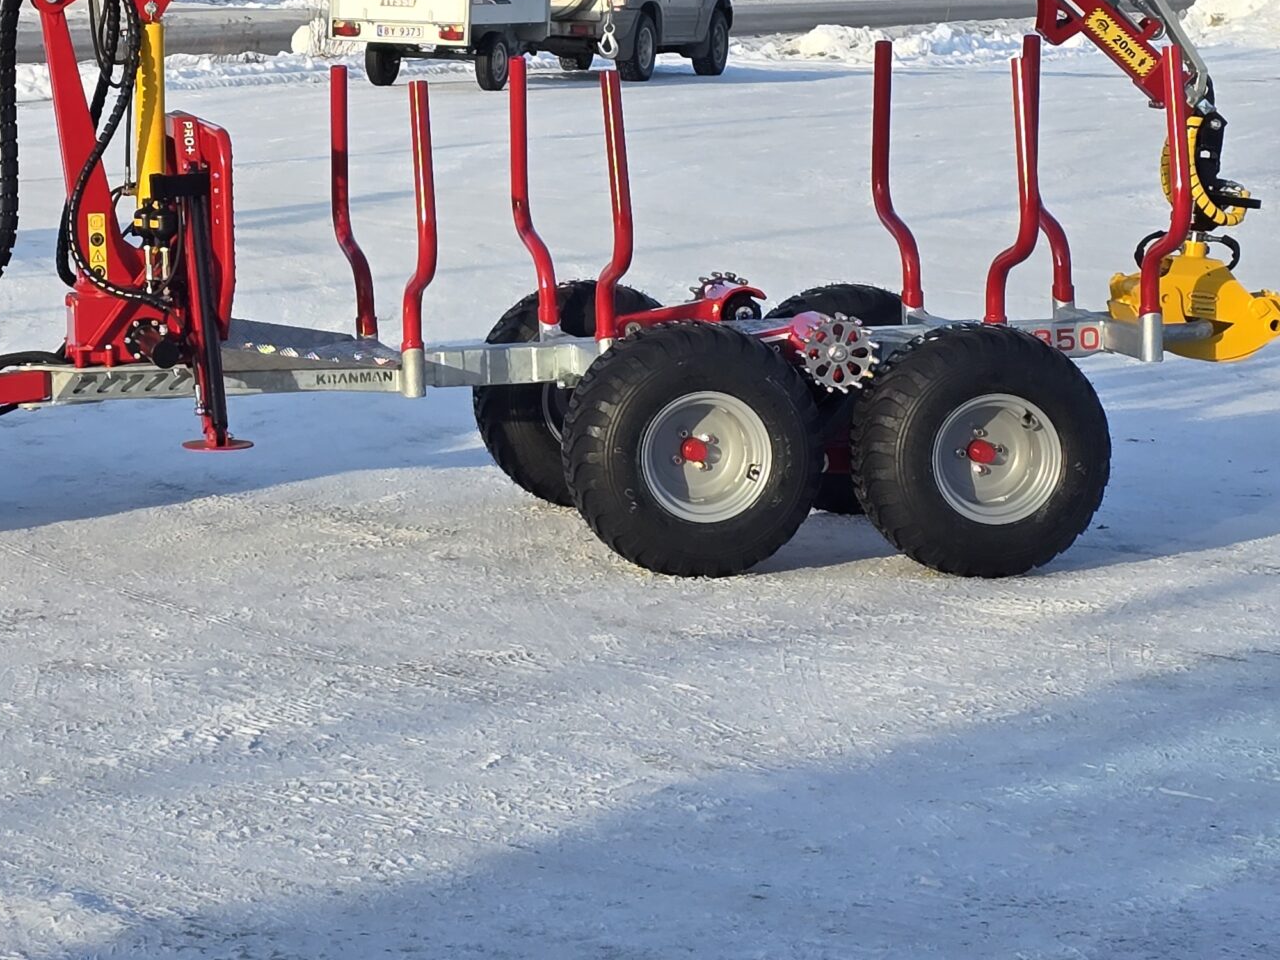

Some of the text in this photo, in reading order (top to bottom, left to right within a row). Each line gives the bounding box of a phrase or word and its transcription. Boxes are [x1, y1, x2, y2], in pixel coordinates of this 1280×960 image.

[1111, 34, 1136, 59] 20m
[183, 121, 195, 155] PRO+
[316, 371, 393, 386] KRANMAN
